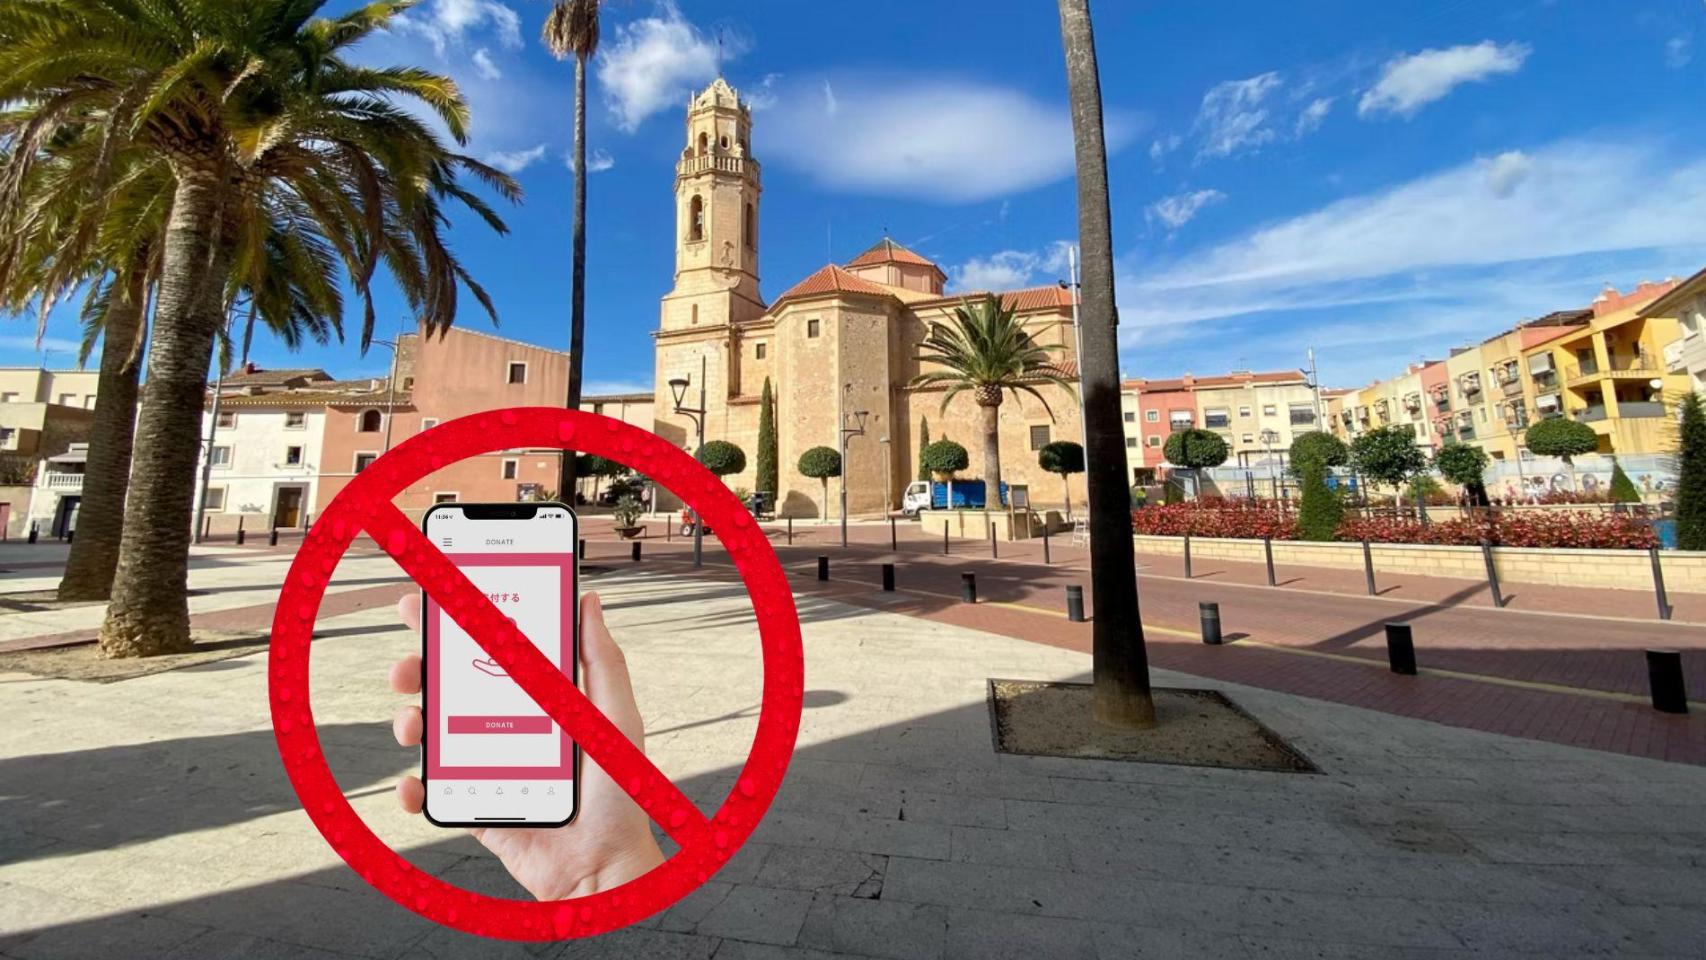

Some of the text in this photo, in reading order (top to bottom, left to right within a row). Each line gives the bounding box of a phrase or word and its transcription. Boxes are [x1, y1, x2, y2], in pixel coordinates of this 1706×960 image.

[484, 593, 520, 603] 付する
[486, 721, 514, 729] DONATE
